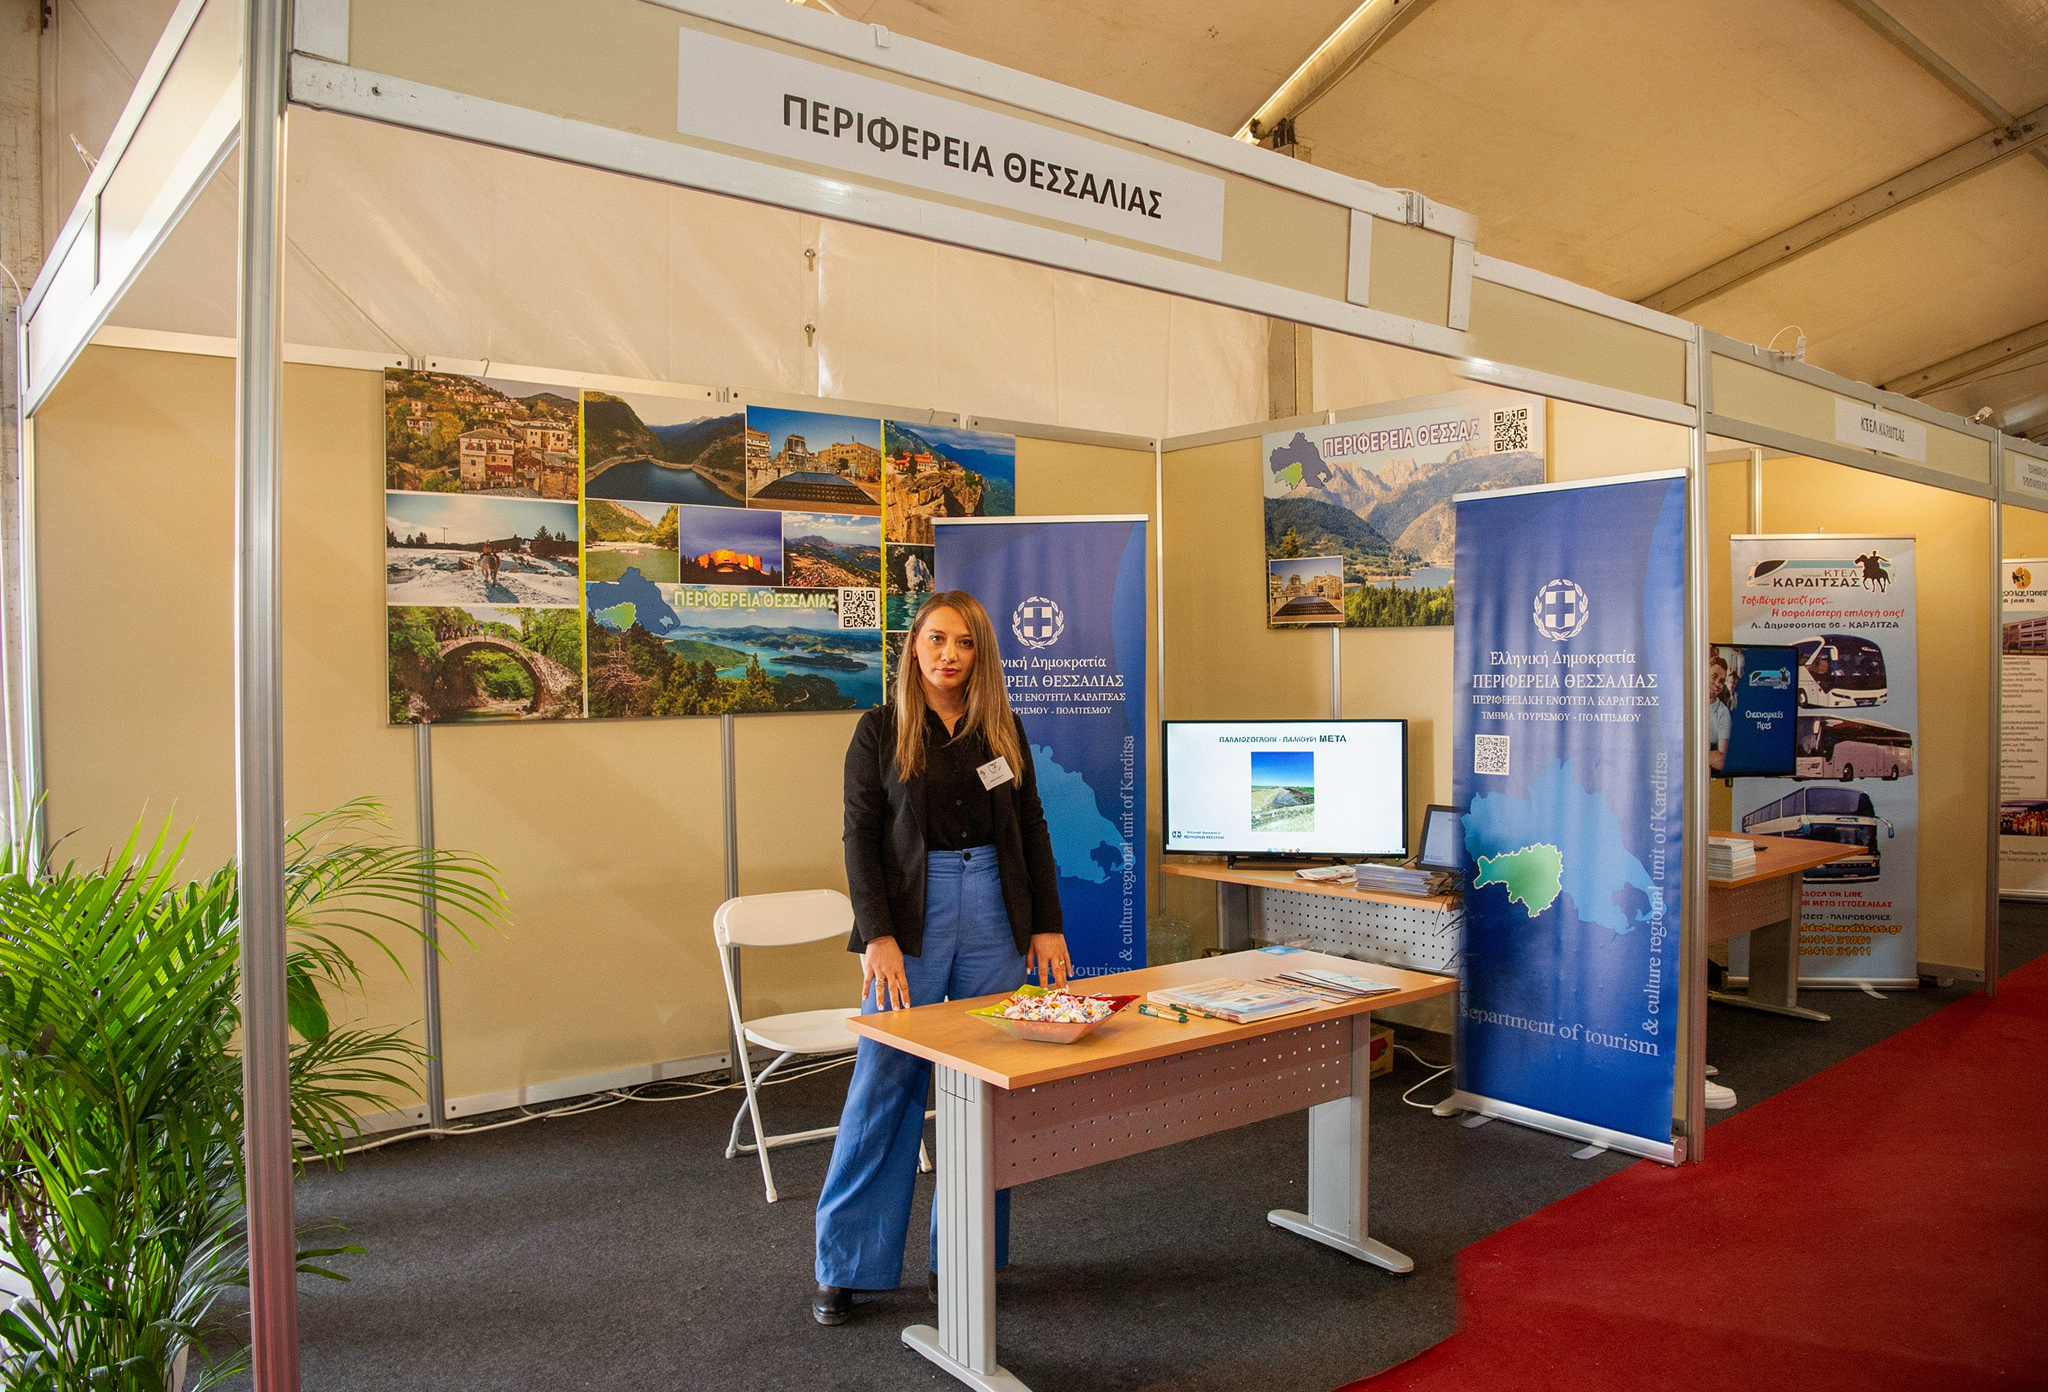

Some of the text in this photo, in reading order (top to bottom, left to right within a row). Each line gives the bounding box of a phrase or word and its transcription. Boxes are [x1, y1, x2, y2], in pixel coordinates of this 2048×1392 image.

[783, 93, 1163, 220] ΠΕΡΙΦΕΡΕΙΑ ΘΕΣΣΑΛΙΑΣ
[1861, 416, 1878, 435] ΚΤΕΛ
[1322, 428, 1415, 458] ΠΕΡΙΦΕΡΕΙΑ
[1824, 569, 1858, 578] ΚΤΕΛ
[1773, 577, 1861, 588] ΚΑΡΔΙΤΣΑΣ
[674, 589, 836, 609] ΠΕΡΙΦΕΡΕΙΑ ΘΕΣΣΑΛΙΑΣ
[1031, 655, 1107, 670] Δημοκρατία
[1490, 650, 1636, 668] Ελληνική Δημοκρατία
[1042, 674, 1124, 688] ΘΕΣΣΑΛΙΑΣ
[1472, 673, 1658, 689] ΠΕΡΙΦΕΡΕΙΑ ΘΕΣΣΑΛΙΑΣ
[1025, 692, 1071, 702] ΕΝΟΤΗΤΑ
[1073, 692, 1126, 702] ΚΑΡΔΙΤΣΑΣ
[1472, 694, 1544, 705] ΠΕΡΙΦΕΡΕΙΑΚΗ
[1597, 695, 1660, 706] ΚΑΡΔΙΤΣΑΣ
[1056, 706, 1112, 715] ΠΟΛΙΤΙΣΜΟΥ
[1481, 711, 1515, 721] ΤΜΗΜΑ
[1517, 712, 1570, 722] ΤΟΥΡΙΣΜΟΥ
[1578, 712, 1641, 723] ΠΟΛΙΤΙΣΜΟΥ
[1319, 734, 1347, 743] ΜΕΤΑ
[1118, 735, 1136, 961] & culture regional unit of Karditsa
[1642, 751, 1668, 1036] & culture regional unit of Karditsa
[1559, 1023, 1583, 1041] of
[1585, 1029, 1660, 1056] tourism
